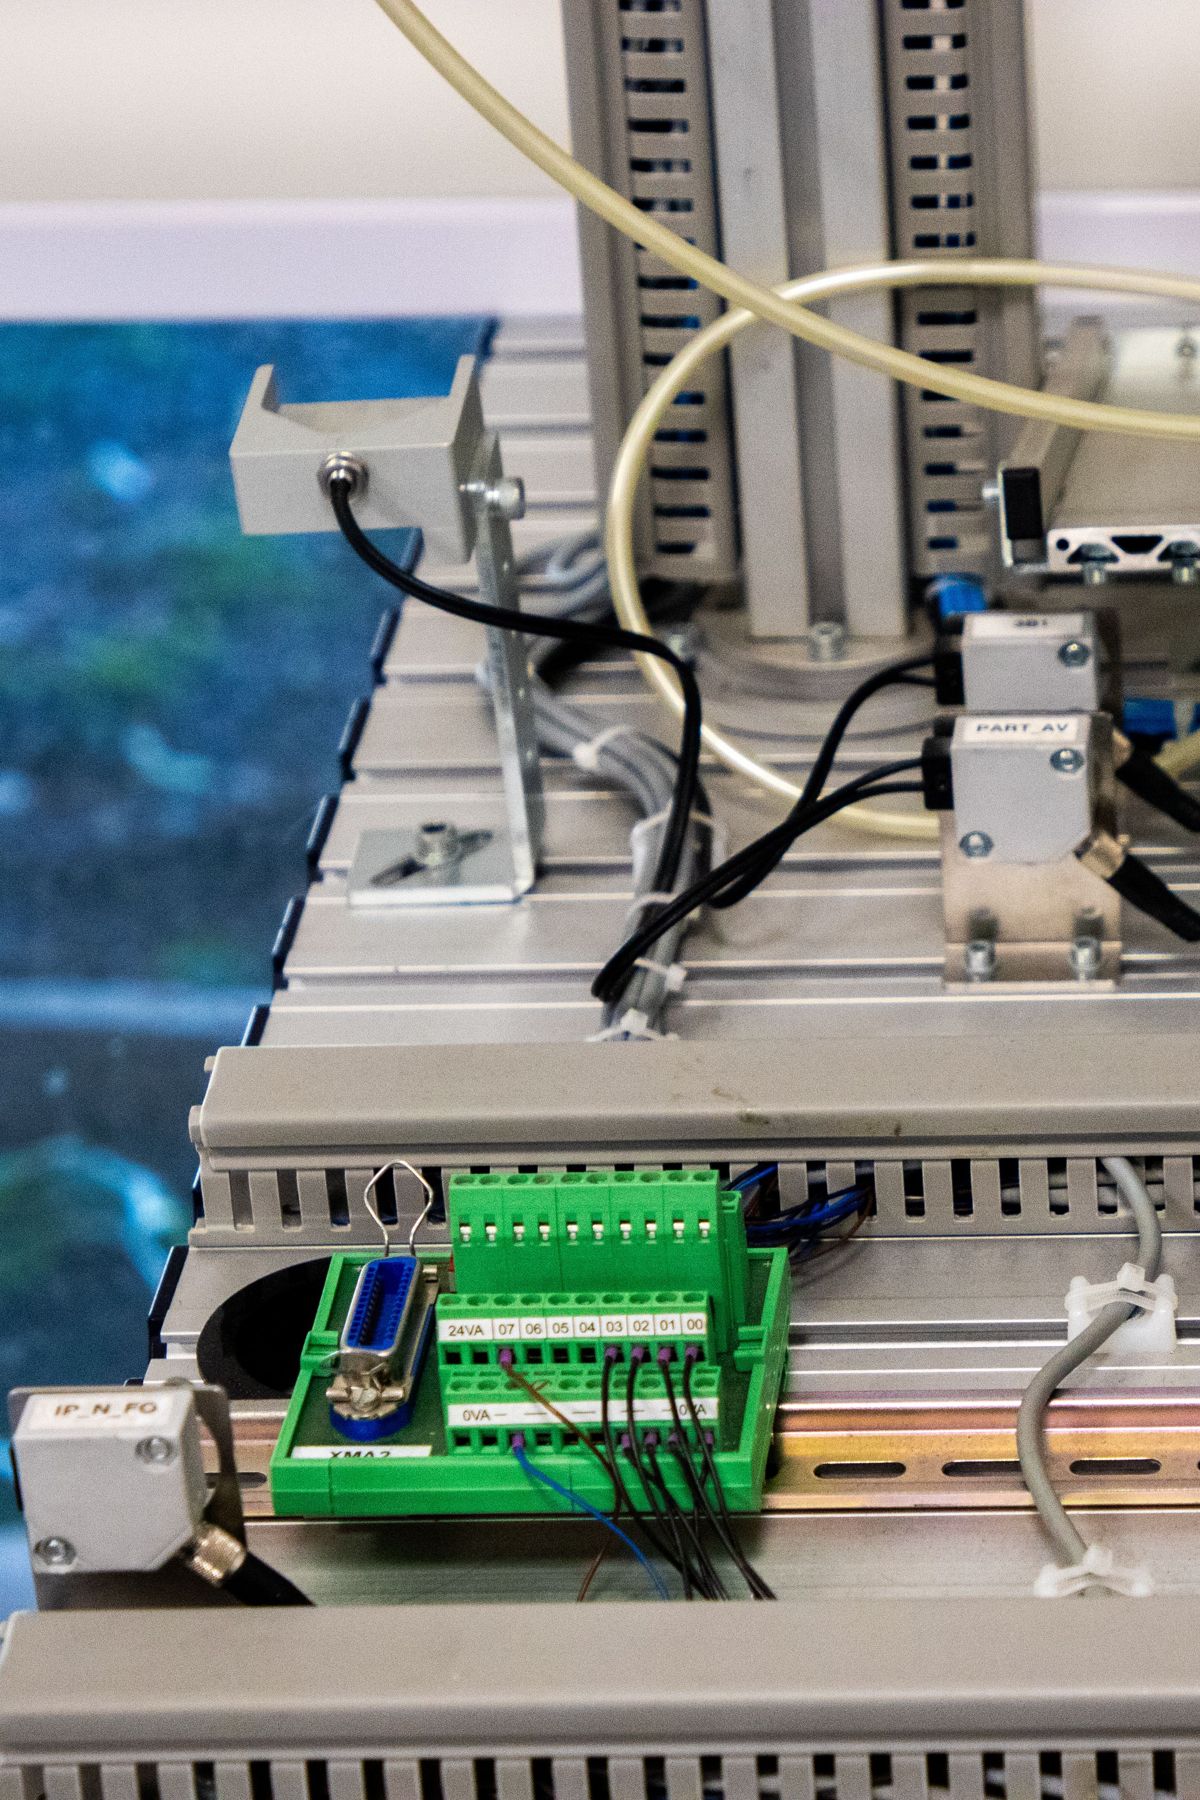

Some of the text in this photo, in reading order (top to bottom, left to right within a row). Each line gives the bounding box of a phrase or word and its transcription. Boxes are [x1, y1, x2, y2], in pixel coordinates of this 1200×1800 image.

[976, 722, 1069, 735] PART_AV
[448, 1318, 704, 1337] 24VA 07 06 05 04 03 02 01 00
[54, 1402, 157, 1419] IP_N_FO
[462, 1409, 491, 1422] 0VA
